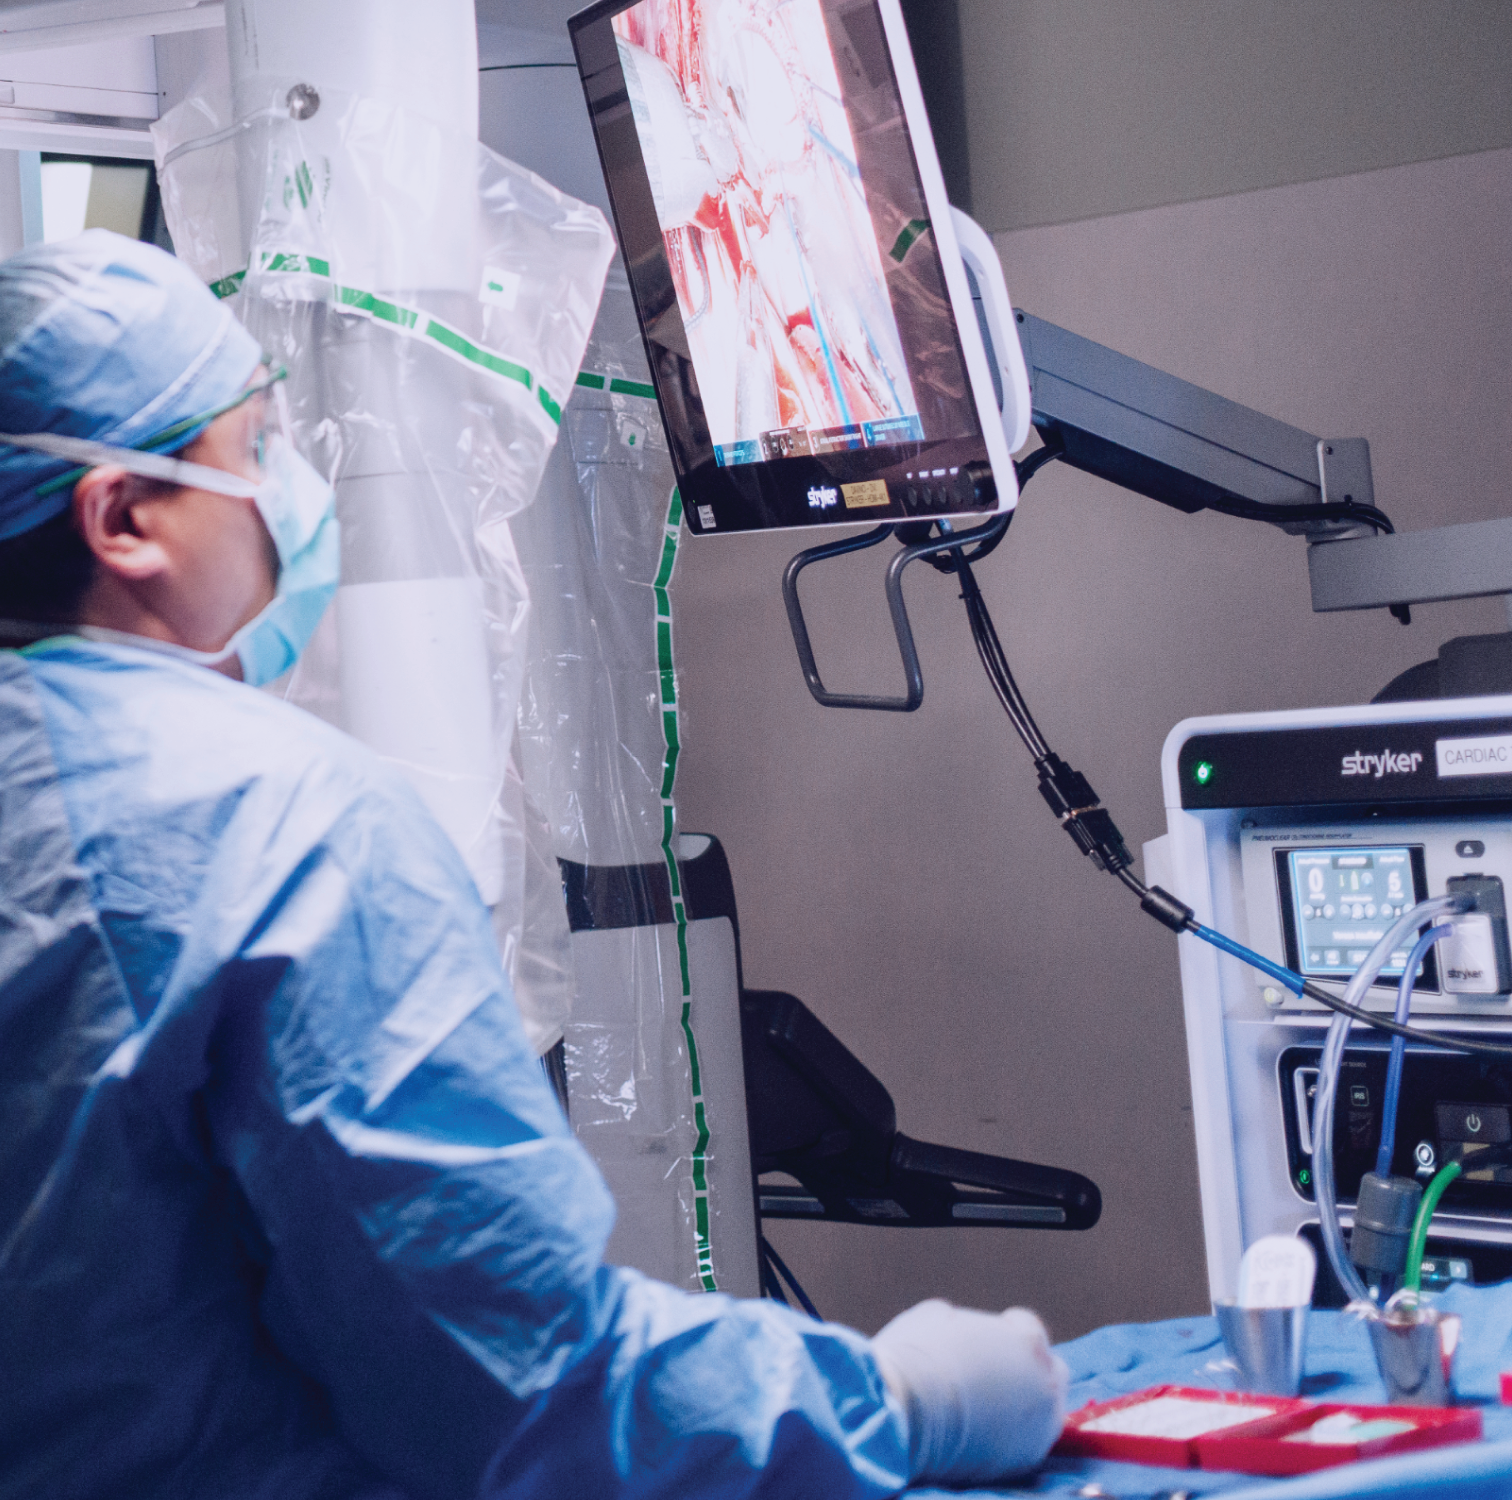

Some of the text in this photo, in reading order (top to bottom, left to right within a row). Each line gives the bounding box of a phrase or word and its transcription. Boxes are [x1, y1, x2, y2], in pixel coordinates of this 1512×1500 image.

[807, 486, 838, 508] stryker
[1341, 749, 1423, 778] stryker
[1445, 746, 1508, 765] CARDIAC
[1308, 868, 1324, 893] 0
[1447, 966, 1484, 980] stryker
